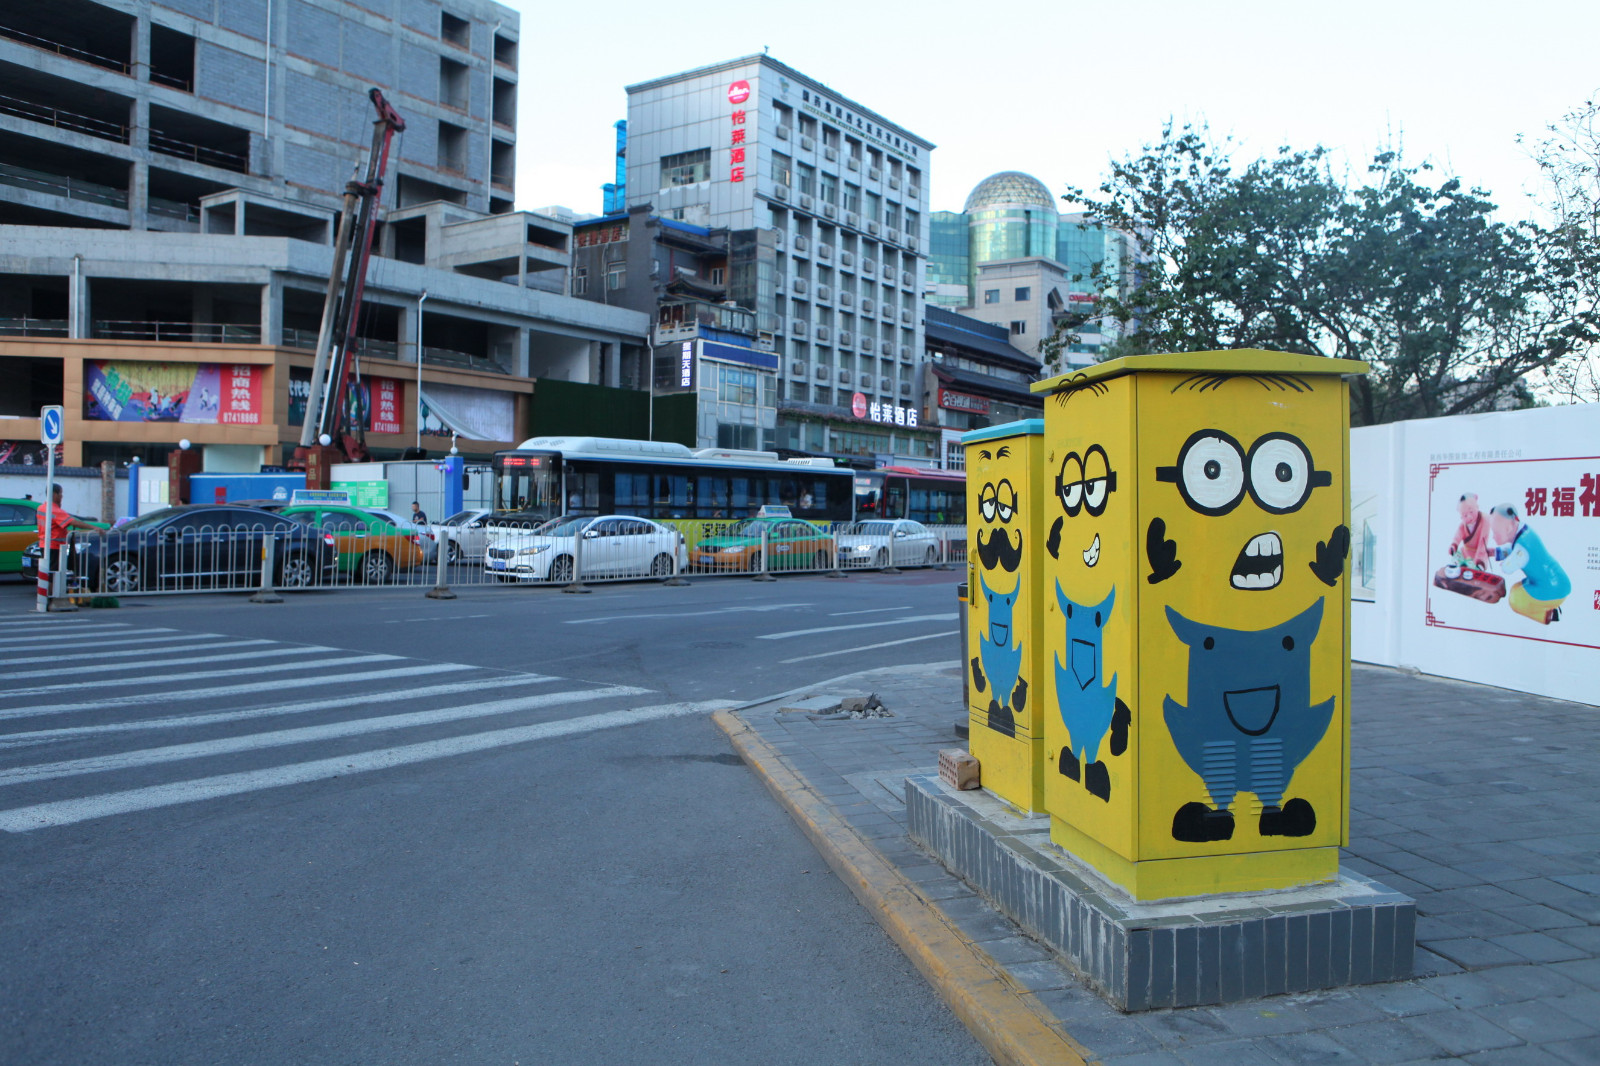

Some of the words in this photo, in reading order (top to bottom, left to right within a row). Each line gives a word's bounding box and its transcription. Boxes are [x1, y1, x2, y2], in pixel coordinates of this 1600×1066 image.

[729, 109, 746, 182] 怡莱酒店
[681, 341, 692, 387] 星期天酒店
[231, 367, 251, 411] 招商热线
[380, 380, 395, 422] 招商热线
[870, 402, 917, 427] 怡莱酒店
